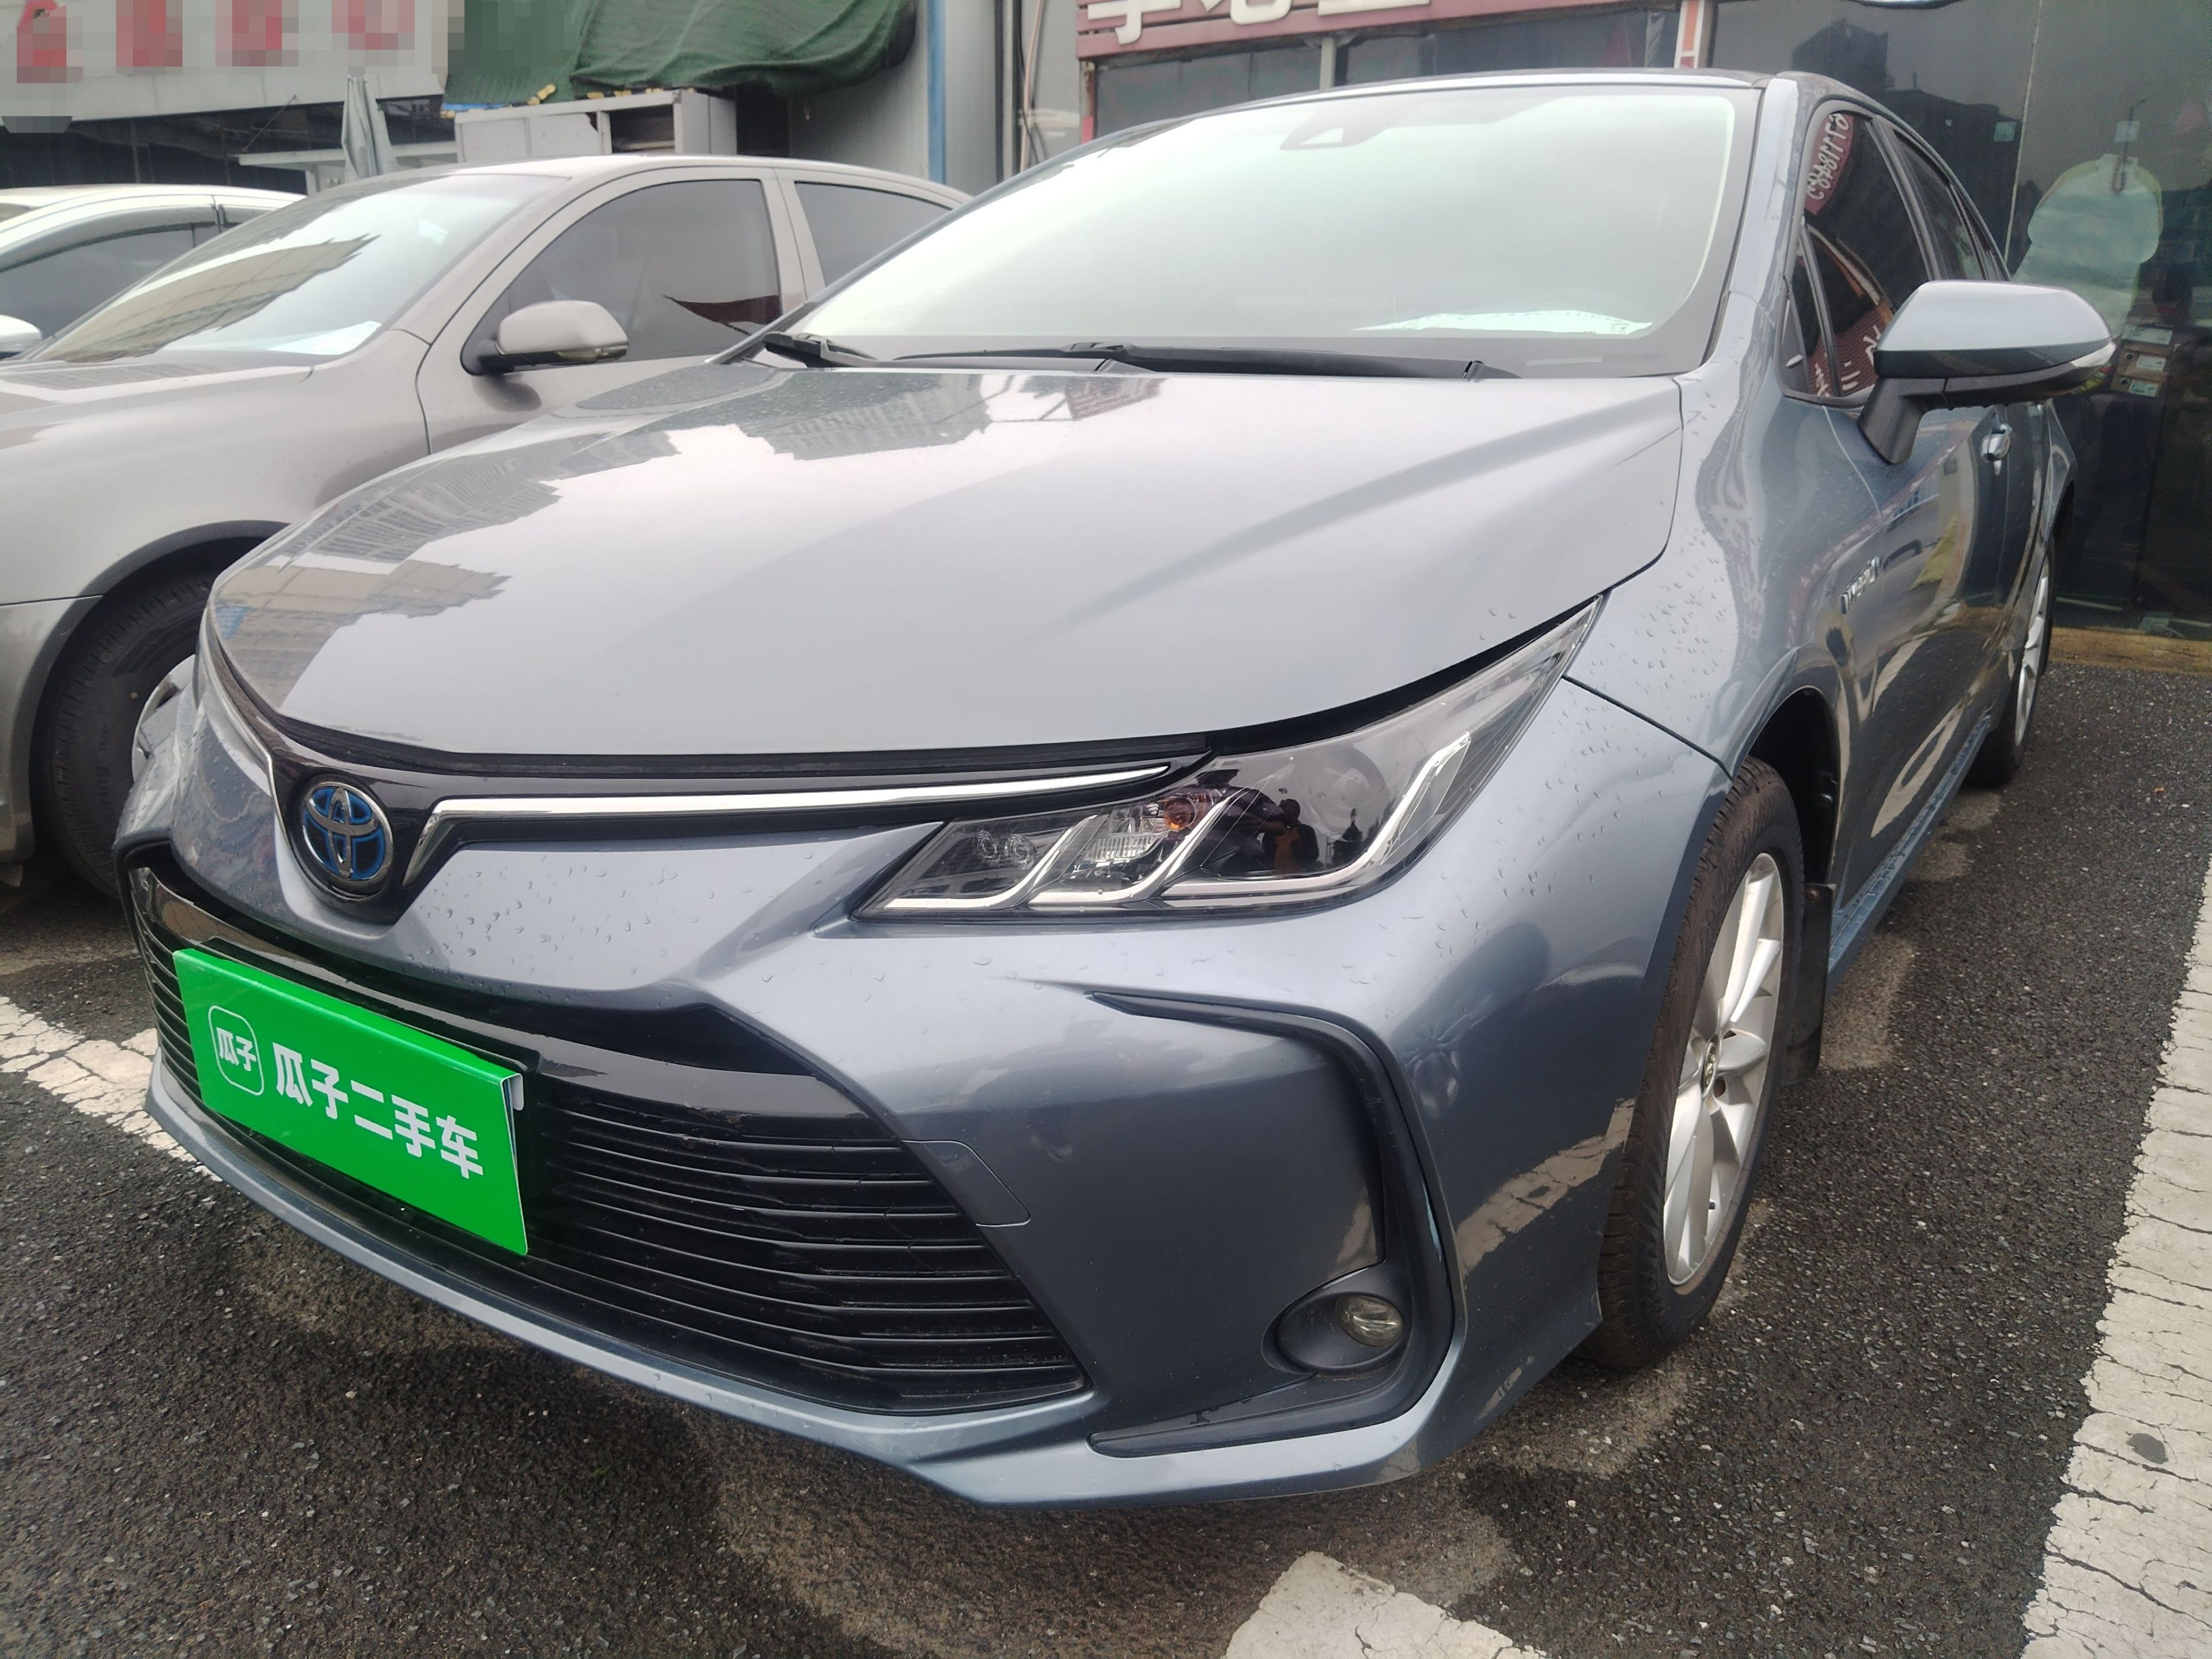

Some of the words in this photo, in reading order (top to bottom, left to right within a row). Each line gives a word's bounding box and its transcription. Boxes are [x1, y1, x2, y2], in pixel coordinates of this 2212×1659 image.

[216, 1027, 257, 1071] 瓜子
[272, 1042, 483, 1179] 瓜子二手车
